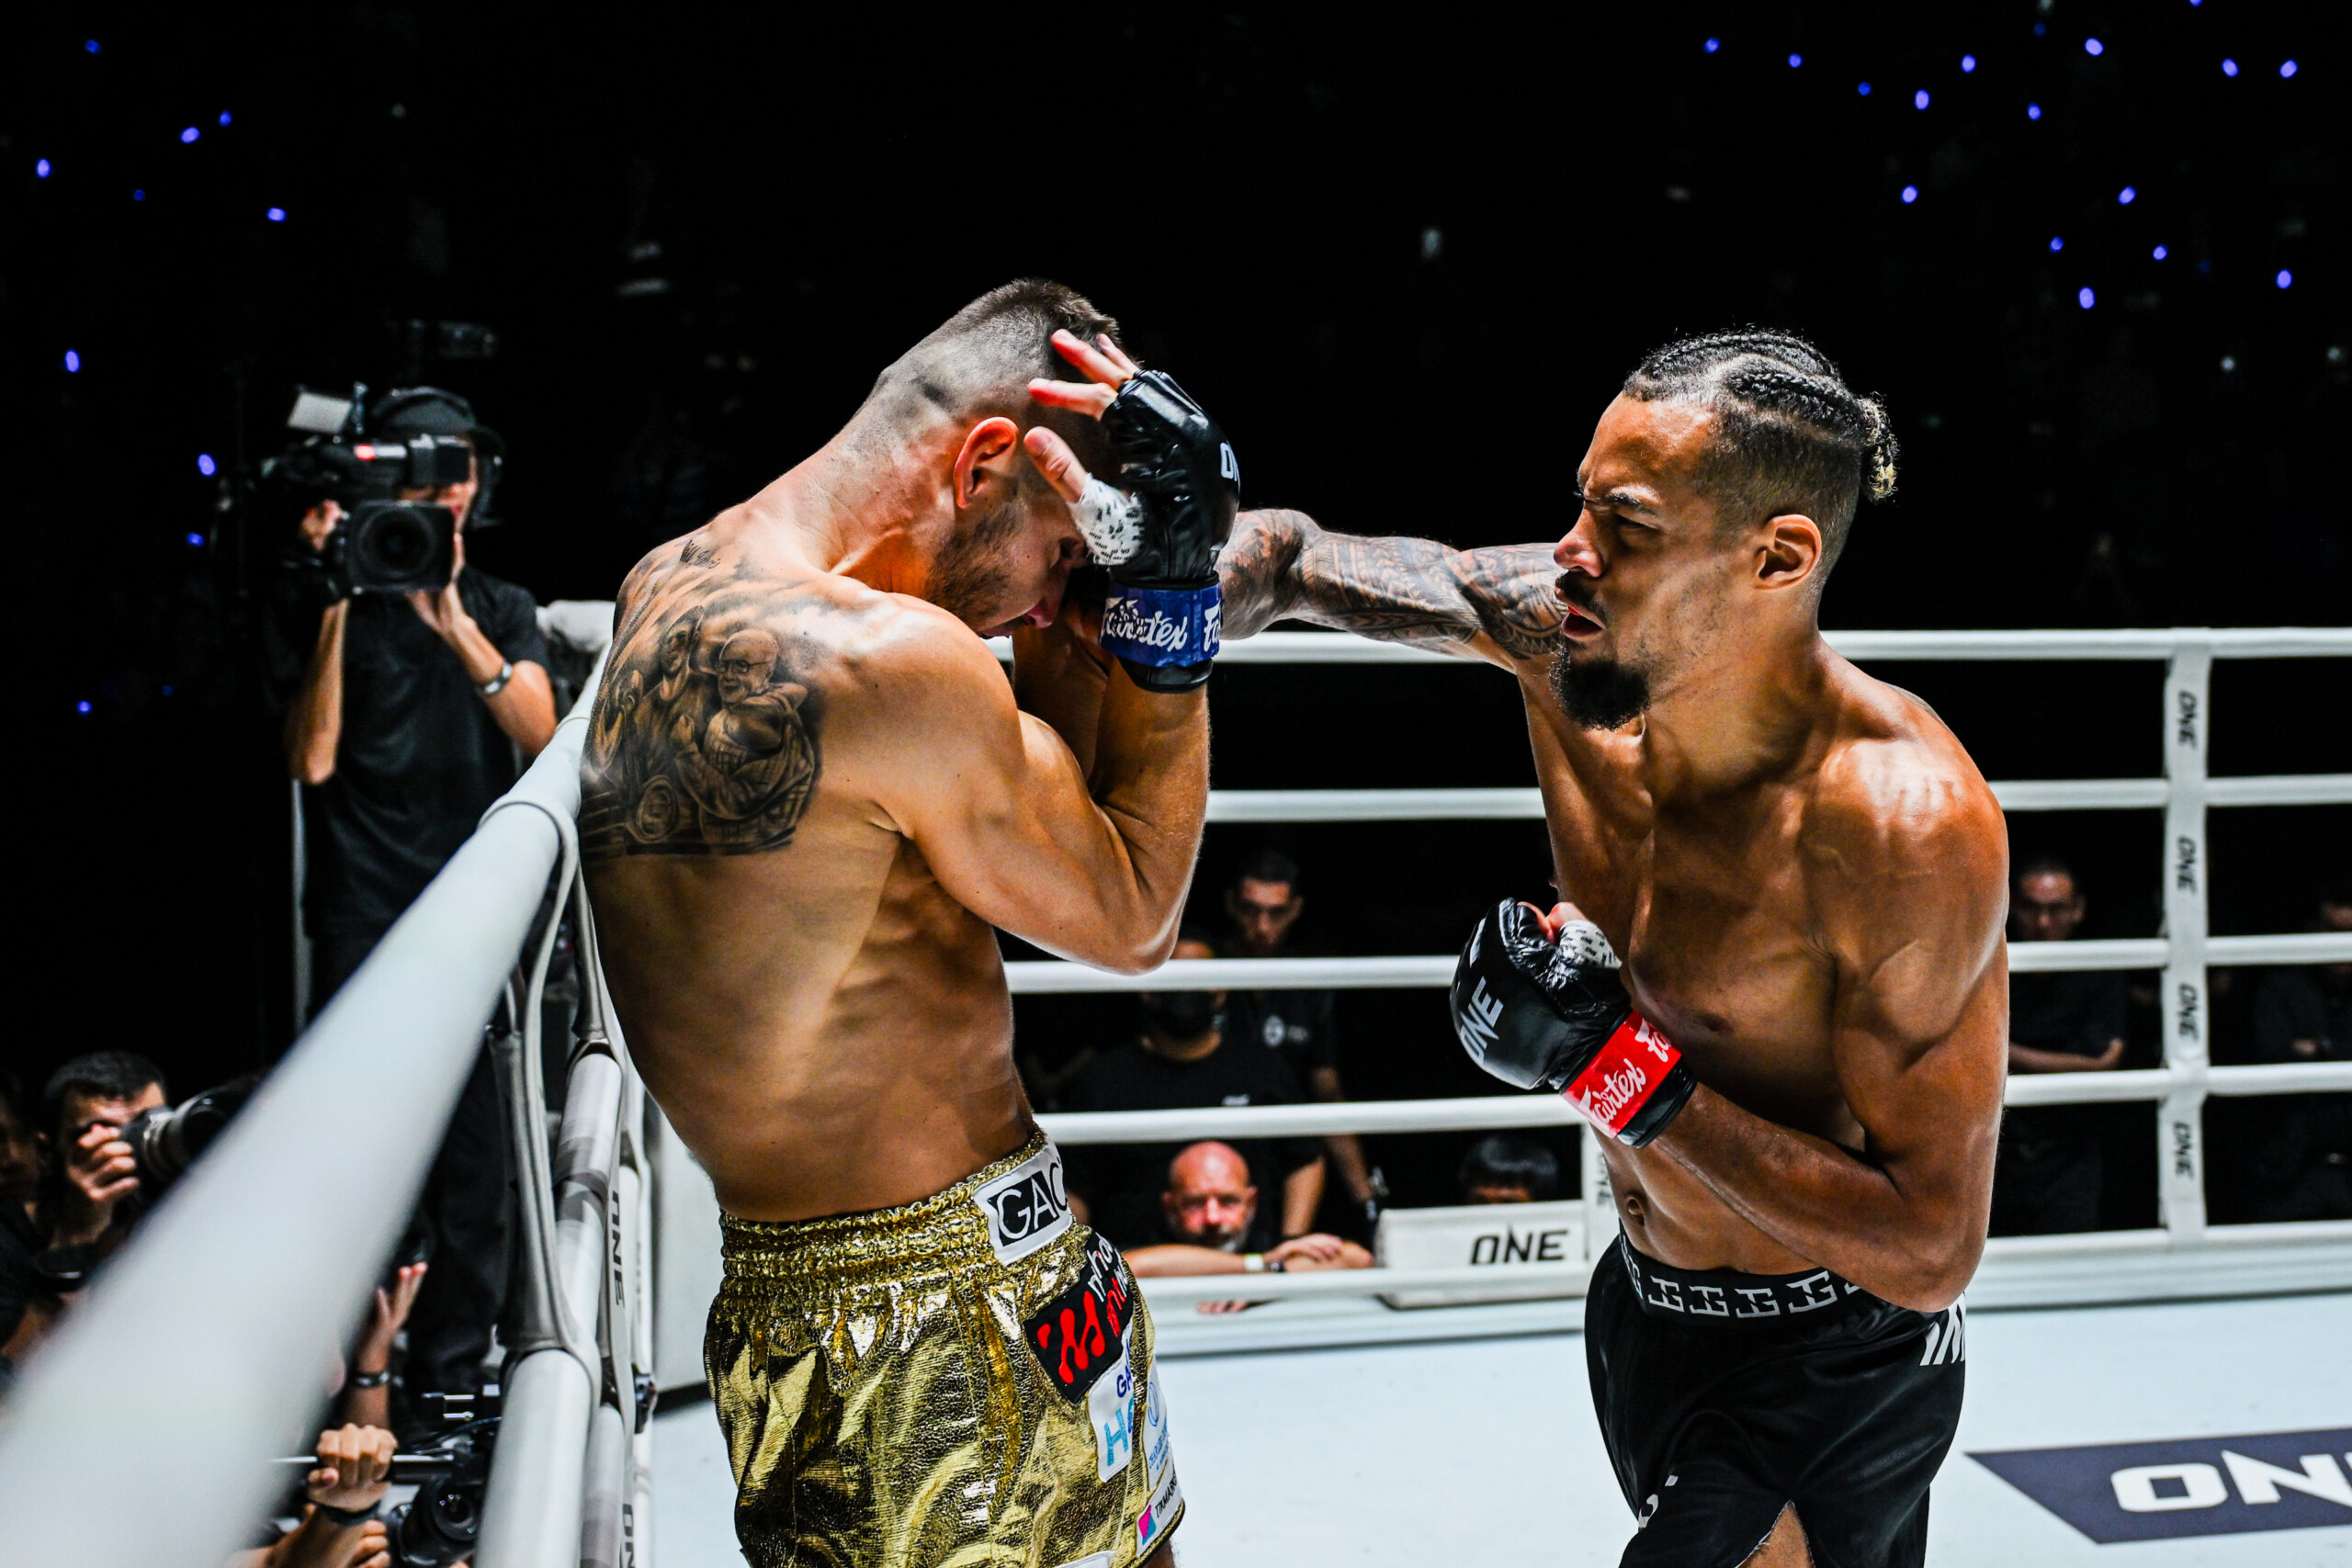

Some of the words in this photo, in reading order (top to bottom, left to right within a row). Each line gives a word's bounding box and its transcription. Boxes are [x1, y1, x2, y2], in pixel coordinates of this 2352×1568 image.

[1460, 976, 1504, 1066] ONE
[1578, 1058, 1646, 1128] Fairtex
[1472, 1229, 1569, 1265] ONE
[2110, 1450, 2352, 1515] ON
